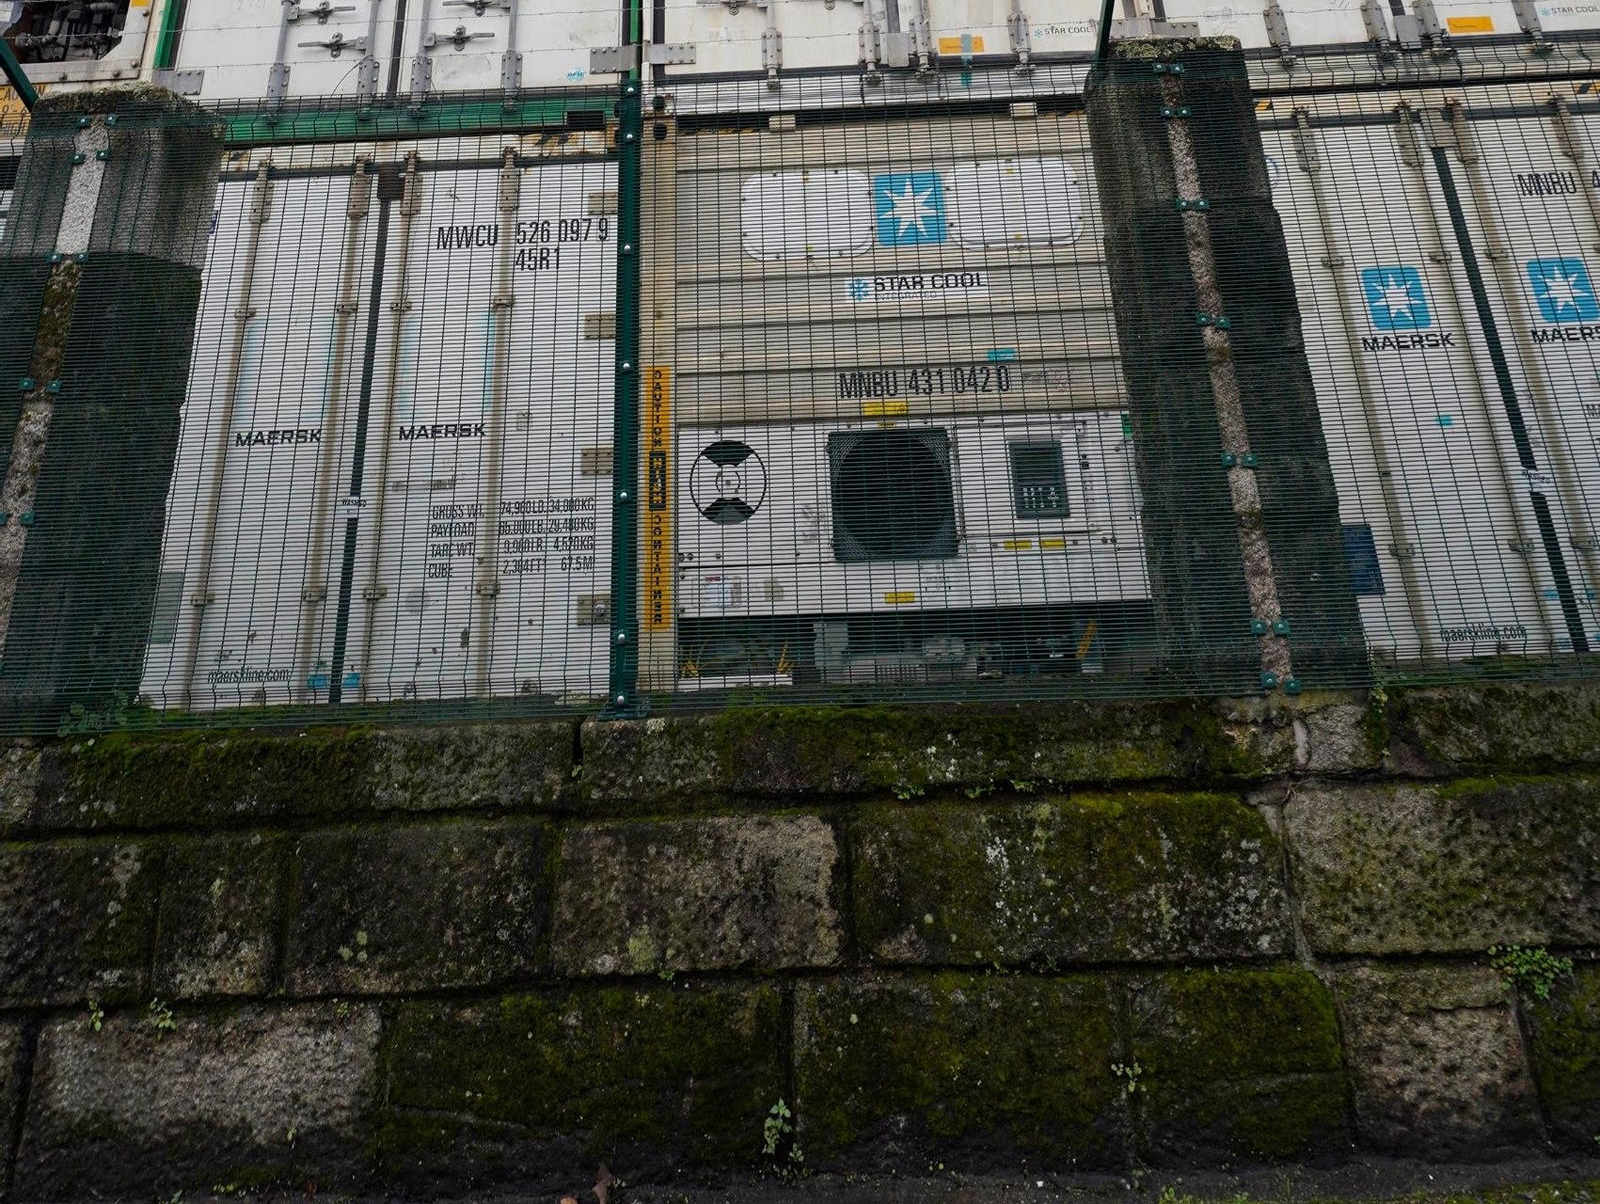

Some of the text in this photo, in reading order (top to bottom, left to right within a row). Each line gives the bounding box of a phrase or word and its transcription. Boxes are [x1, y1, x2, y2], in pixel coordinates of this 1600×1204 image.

[1551, 5, 1600, 14] STAR COOL
[1044, 26, 1092, 35] STAR COOL
[1516, 171, 1577, 196] MNBU
[436, 217, 609, 249] MWCU 526 097 9
[515, 246, 560, 271] 45R1
[873, 272, 987, 292] STAR COOL
[1362, 332, 1456, 352] MAERSK
[839, 365, 1010, 398] MNBU 431 042 0
[235, 428, 322, 447] MAERSK
[400, 422, 487, 441] MAERSK
[207, 665, 292, 684] maerskline.com
